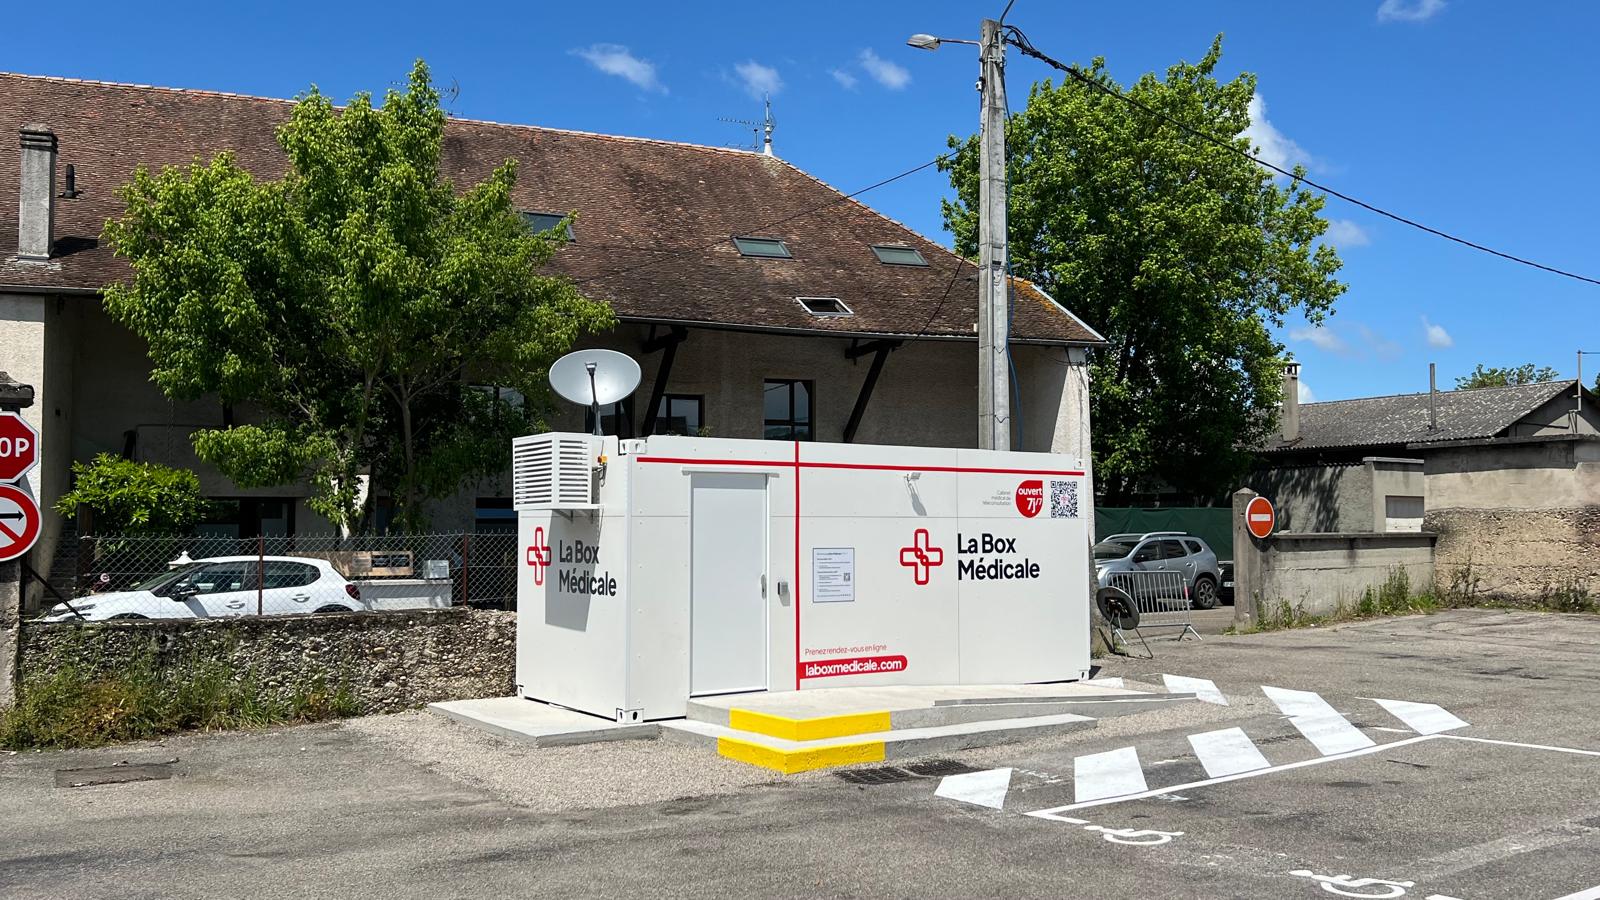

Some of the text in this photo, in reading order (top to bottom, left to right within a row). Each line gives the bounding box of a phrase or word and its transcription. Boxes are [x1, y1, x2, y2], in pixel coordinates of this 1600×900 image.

[0, 437, 30, 458] OP
[1018, 487, 1042, 496] ouvert
[559, 540, 600, 564] La Box
[957, 533, 1016, 554] La Box
[958, 557, 1040, 580] Médicale
[559, 568, 617, 596] Médicale
[826, 646, 864, 654] rendez-vous
[873, 644, 887, 653] ligne
[806, 660, 902, 676] laboxmedicale.com
